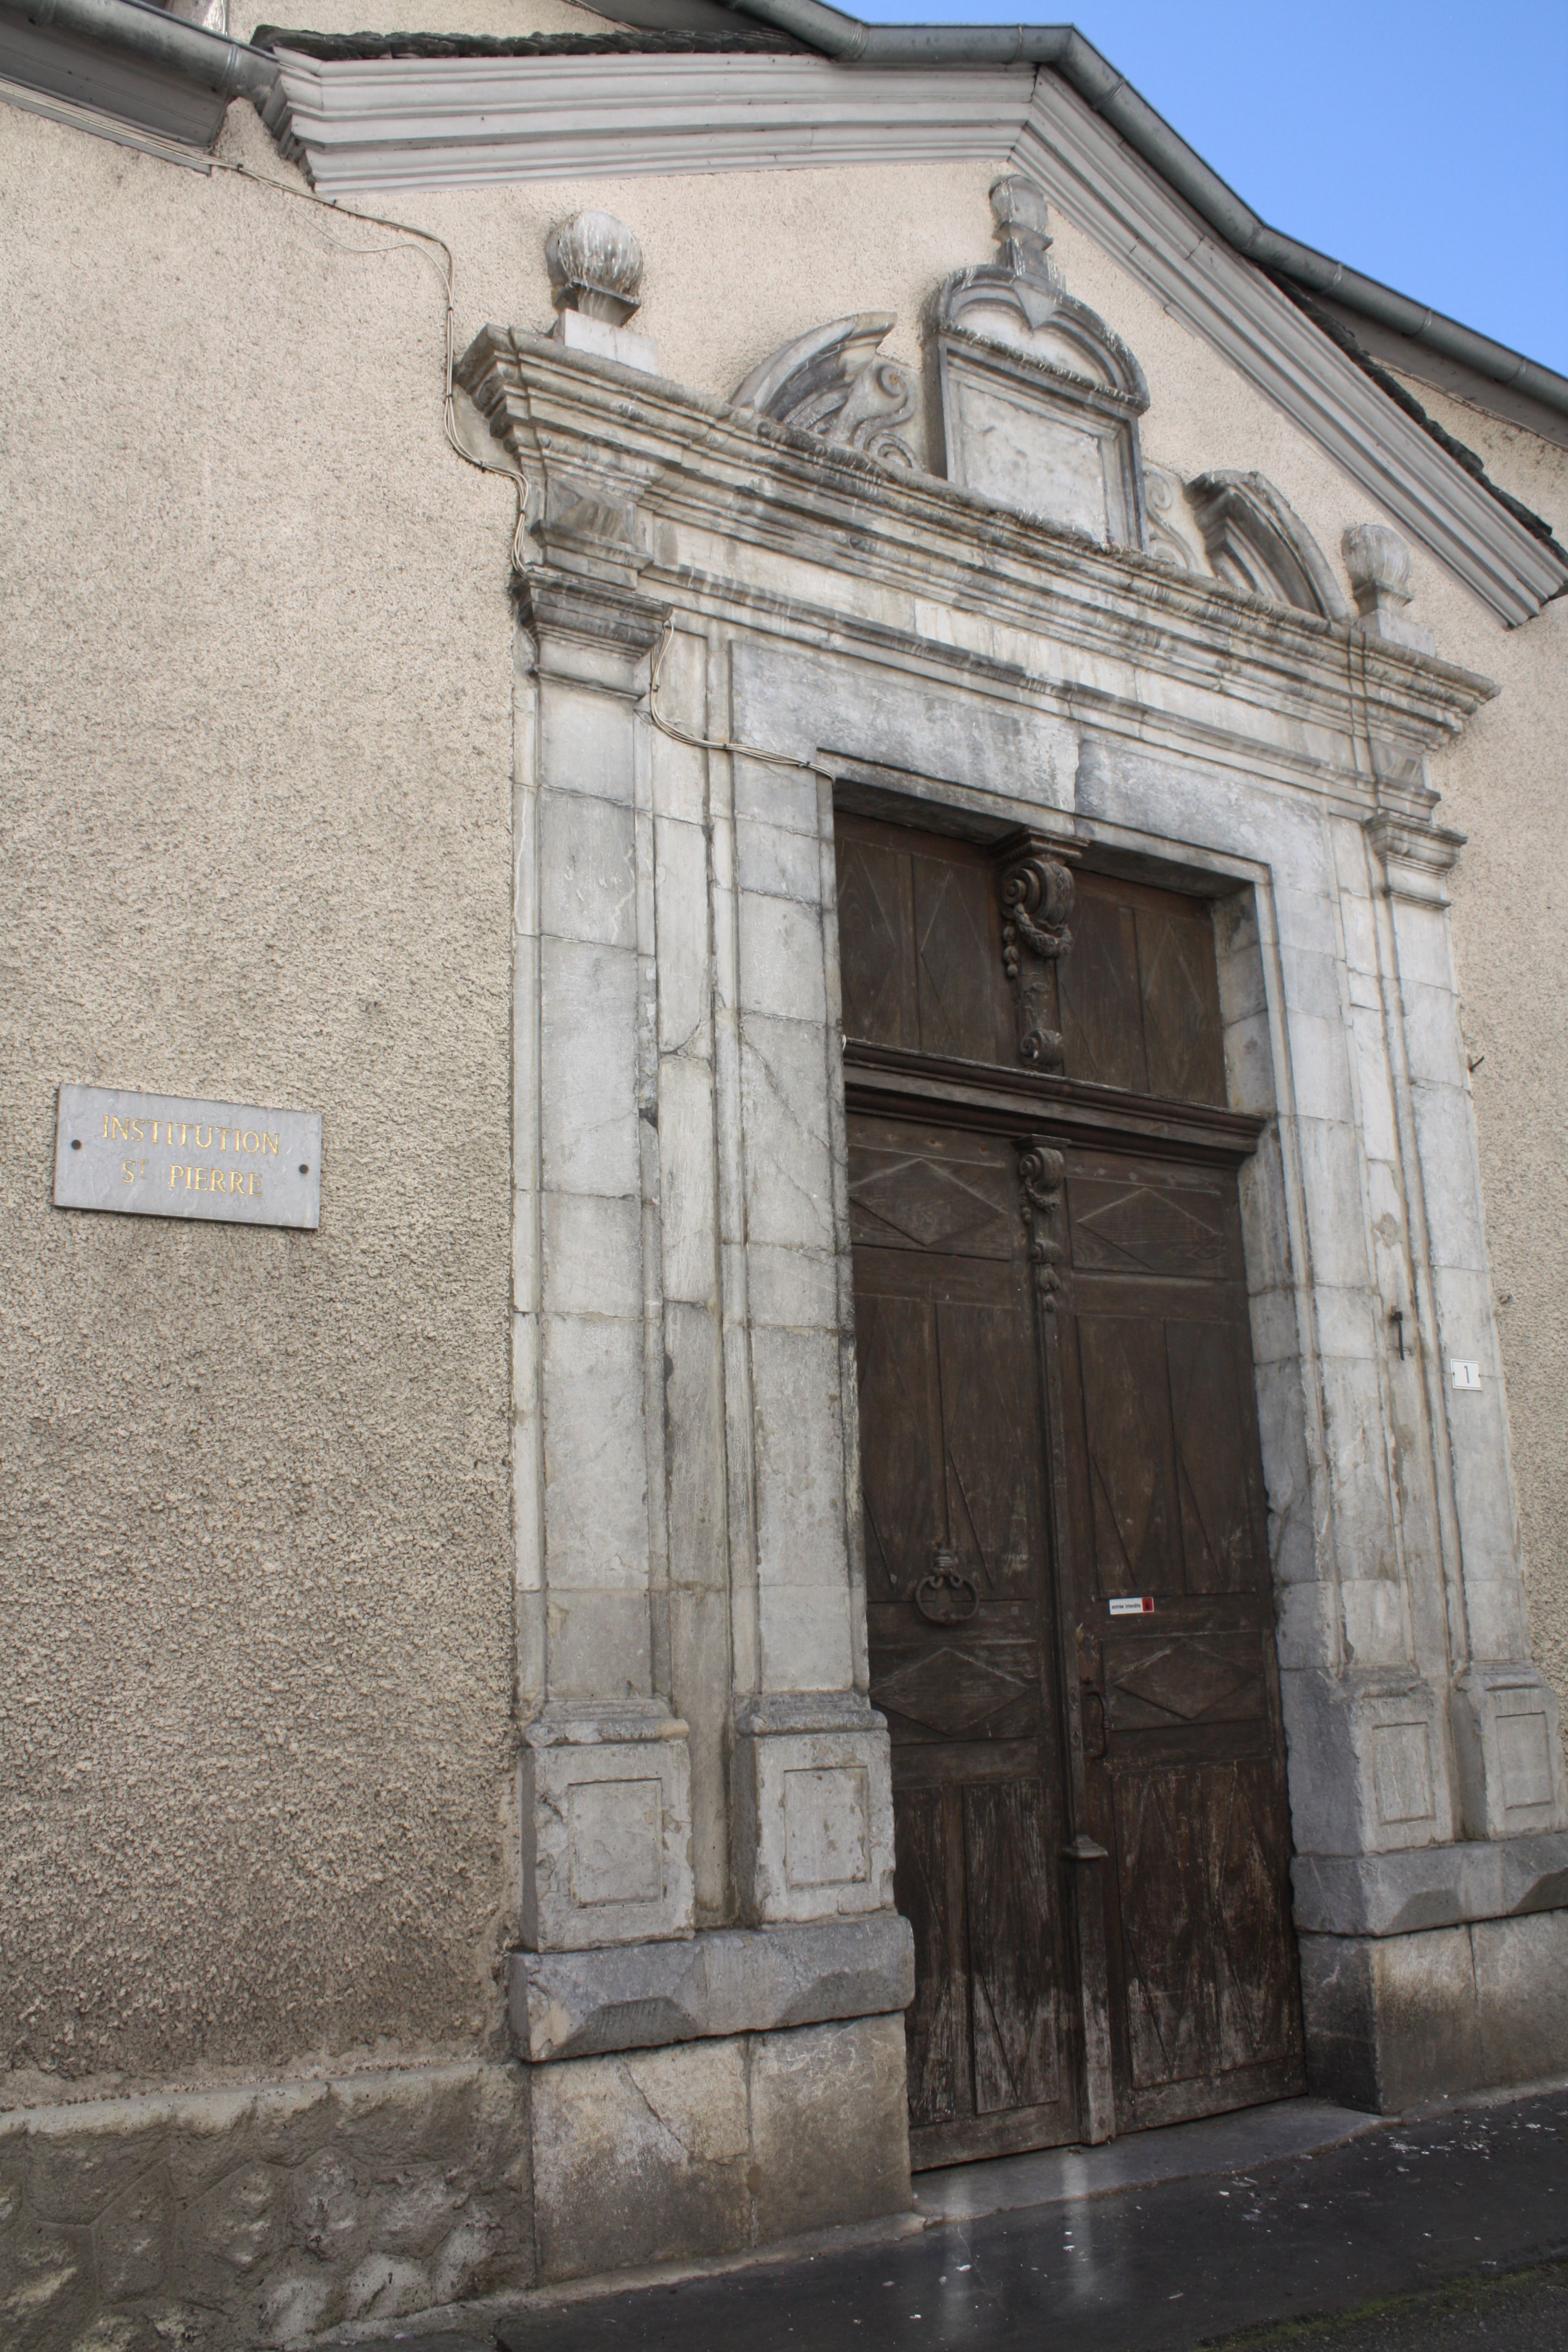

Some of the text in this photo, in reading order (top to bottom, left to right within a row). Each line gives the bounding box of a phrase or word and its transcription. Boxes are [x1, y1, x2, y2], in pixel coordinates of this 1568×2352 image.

[102, 1114, 279, 1155] INSTITUTION
[168, 1164, 263, 1197] PIERRE
[1463, 1365, 1470, 1384] 1
